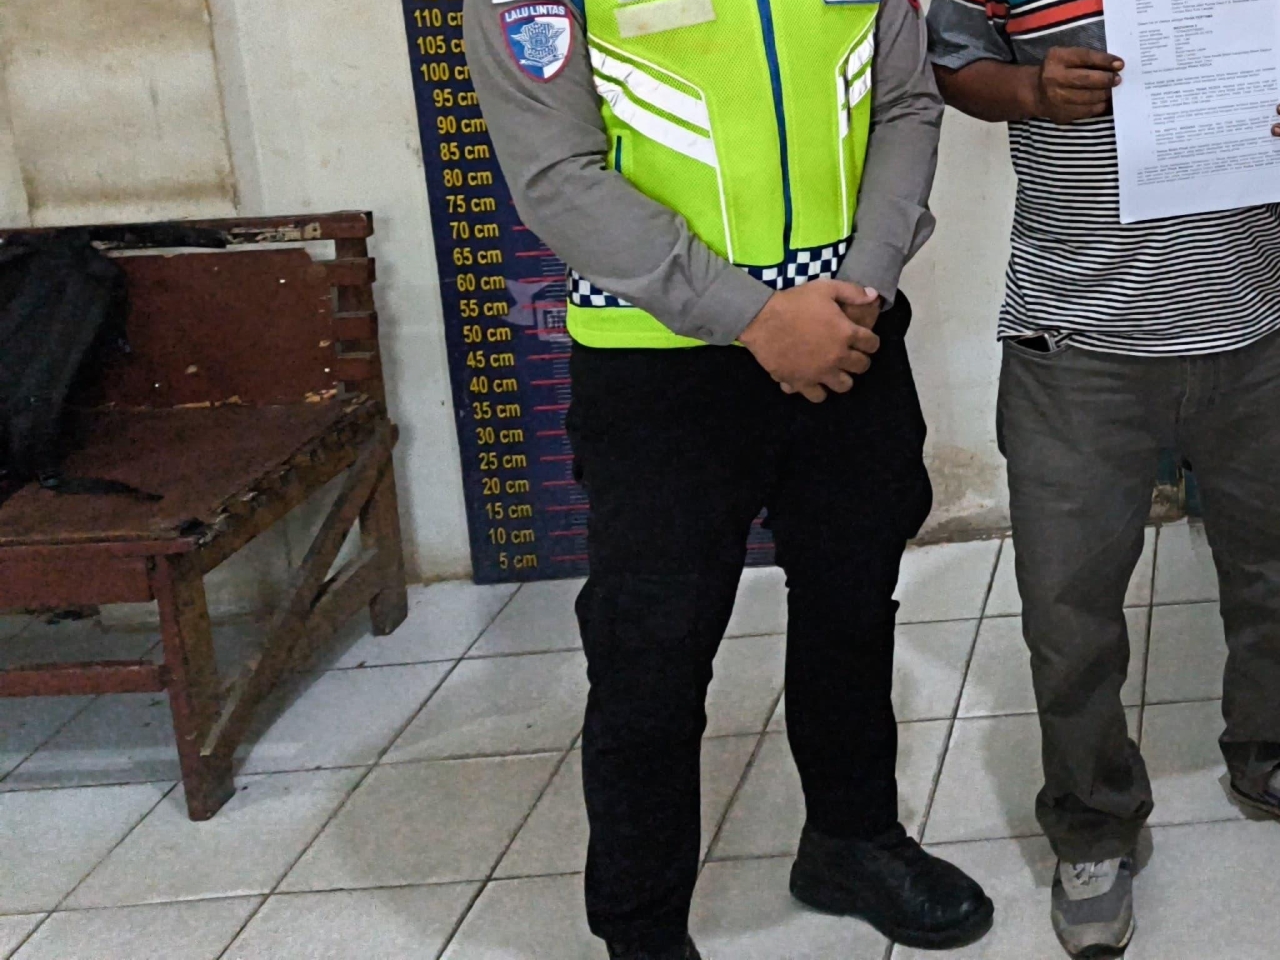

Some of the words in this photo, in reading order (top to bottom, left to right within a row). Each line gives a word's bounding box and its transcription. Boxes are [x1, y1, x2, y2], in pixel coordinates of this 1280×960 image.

[413, 8, 442, 27] 110
[505, 8, 528, 22] LALU
[530, 5, 566, 17] LINTAS
[417, 35, 446, 55] 105
[450, 39, 467, 53] c
[420, 62, 450, 81] 100
[432, 88, 454, 108] 95
[436, 115, 457, 135] 90
[460, 118, 487, 133] cm
[439, 141, 460, 161] 85
[464, 144, 490, 160] cm
[443, 168, 463, 188] 80
[467, 171, 493, 186] cm
[446, 194, 466, 213] 75
[470, 197, 496, 212] cm
[450, 221, 470, 239] 70
[474, 223, 499, 239] cm
[453, 247, 473, 266] 65
[477, 249, 503, 265] cm
[456, 273, 476, 292] 60
[480, 275, 506, 291] cm
[459, 299, 479, 318] 55
[483, 301, 508, 316] cm
[463, 324, 482, 343] 50
[487, 327, 511, 342] cm
[466, 350, 486, 368] 45
[489, 352, 515, 368] cm
[469, 376, 488, 394] 40
[493, 378, 518, 393] cm
[473, 401, 492, 420] 35
[496, 403, 521, 418] cm
[477, 427, 495, 445] 30
[499, 429, 524, 443] cm
[480, 452, 498, 470] 25
[502, 454, 527, 469] cm
[483, 478, 501, 495] 20
[505, 480, 528, 494] cm
[485, 502, 504, 520] 15
[508, 505, 533, 518] cm
[488, 527, 506, 544] 10
[511, 529, 535, 543] cm
[499, 552, 508, 568] 5
[513, 554, 538, 568] cm
